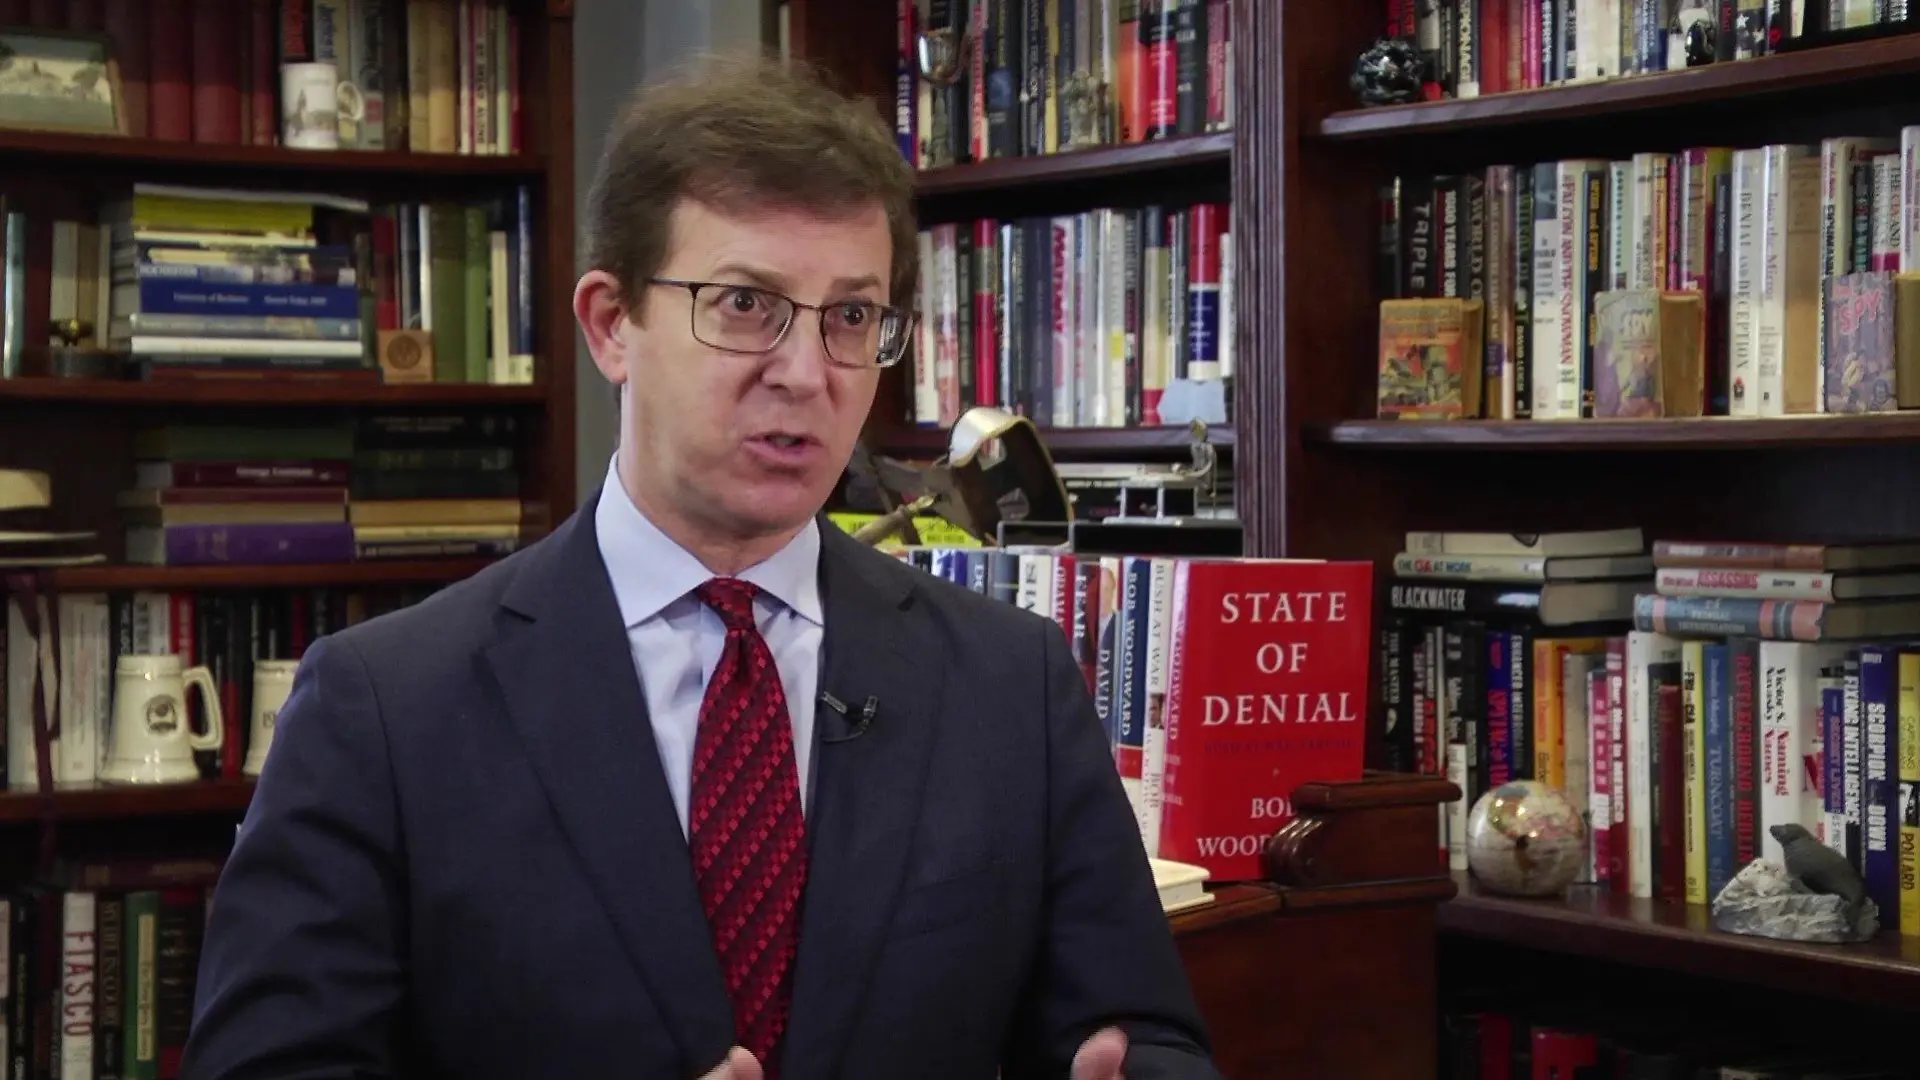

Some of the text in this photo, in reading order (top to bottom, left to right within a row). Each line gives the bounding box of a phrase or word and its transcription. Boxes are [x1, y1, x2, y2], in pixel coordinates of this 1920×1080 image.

[1470, 198, 1484, 273] WORLD
[1563, 181, 1576, 234] FALCON
[1740, 193, 1752, 246] DENIAL
[1890, 166, 1901, 247] THE CIA AND
[1411, 203, 1430, 289] TRIPLE
[1444, 225, 1457, 268] YEARS
[1560, 292, 1574, 364] SNOWMAN
[1736, 281, 1751, 369] DECEPTION
[1840, 287, 1882, 334] SPY
[1055, 566, 1066, 628] OBAMA'
[1398, 559, 1472, 573] THE CIA AT WORK
[1074, 573, 1088, 640] FEAR
[1150, 565, 1166, 687] BUSH AT WAR
[1220, 591, 1347, 624] STATE
[1391, 586, 1467, 612] BLACKWATER
[1098, 648, 1111, 720] DAVID
[1121, 572, 1138, 737] BOB WOODWARD
[1167, 616, 1184, 741] WOODWARD
[1256, 643, 1308, 674] OF
[1388, 657, 1401, 704] MASTER
[1511, 635, 1523, 689] ENHANCED
[1202, 692, 1357, 727] DENIAL
[1684, 704, 1696, 724] CIA
[1776, 668, 1787, 709] Victor
[1612, 677, 1624, 824] Our Man in MEXICO
[1735, 654, 1755, 863] BATTLEGROUND BERLIN
[1764, 731, 1777, 785] Names
[1777, 731, 1791, 797] Naming
[1844, 676, 1861, 825] FIXING INTELLIGENCE
[1867, 703, 1887, 851] SCORPION DOWN
[1709, 747, 1724, 839] TURNCOAT
[1197, 836, 1272, 858] WOOD
[1901, 832, 1916, 891] POLLARD
[65, 931, 98, 1037] FIASCO
